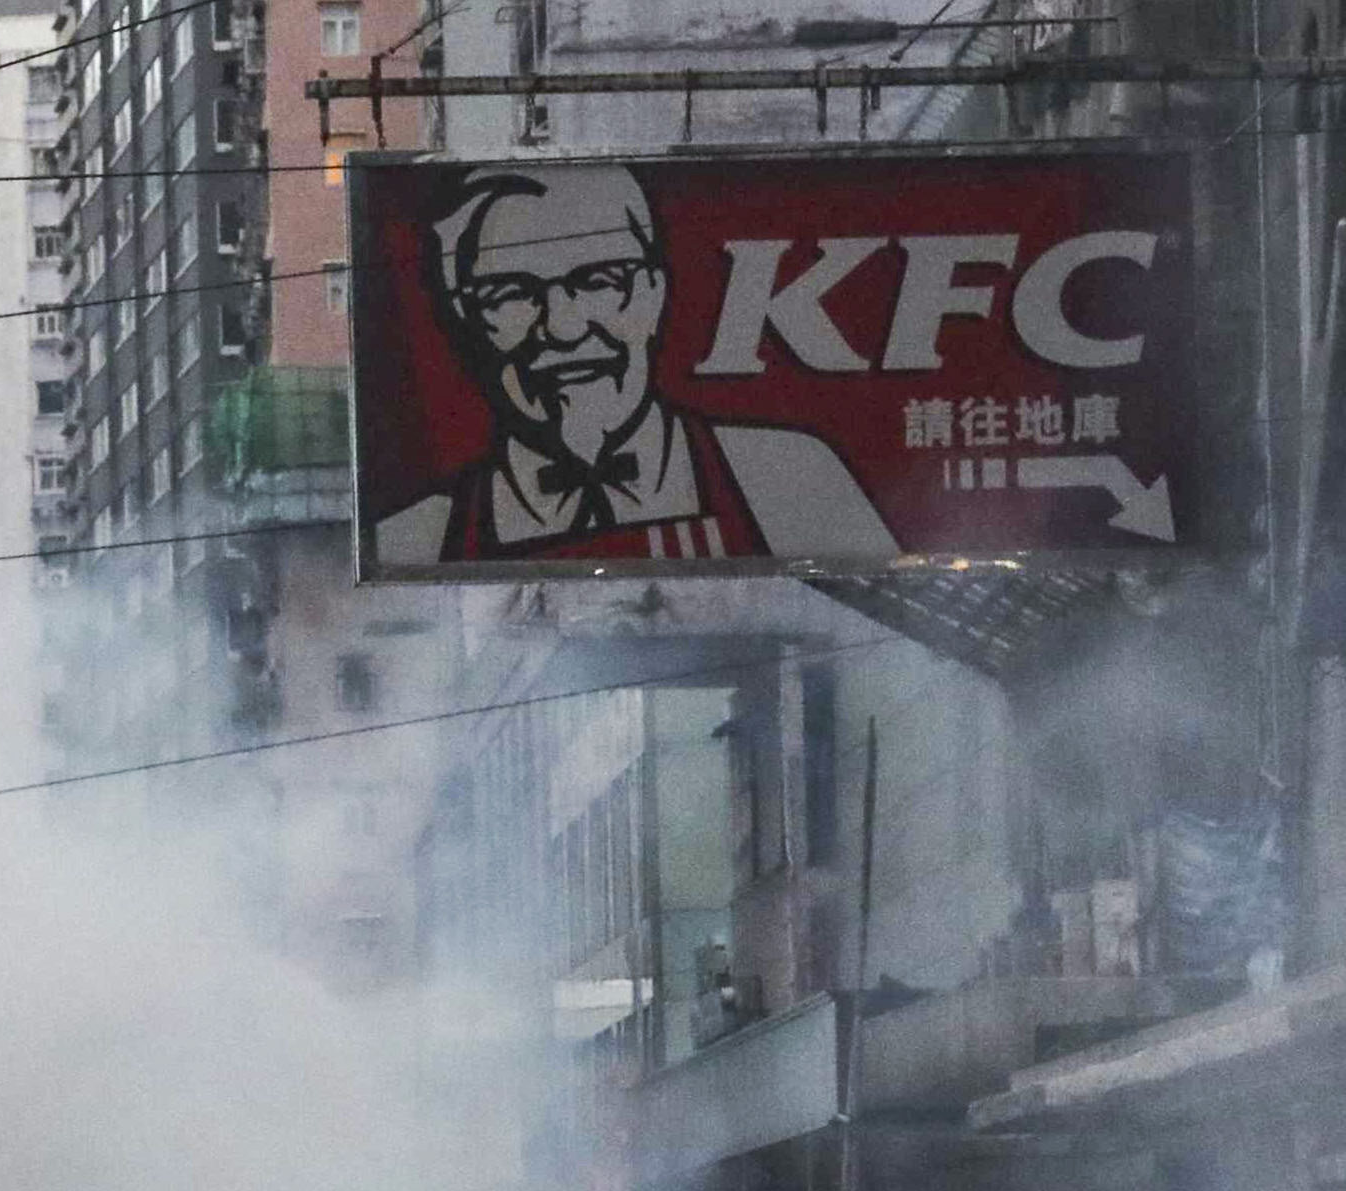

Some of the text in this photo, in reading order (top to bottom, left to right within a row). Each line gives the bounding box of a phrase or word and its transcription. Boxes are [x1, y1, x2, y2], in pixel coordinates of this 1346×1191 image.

[694, 230, 1159, 374] KFC
[904, 395, 1121, 447] 請往地庫
